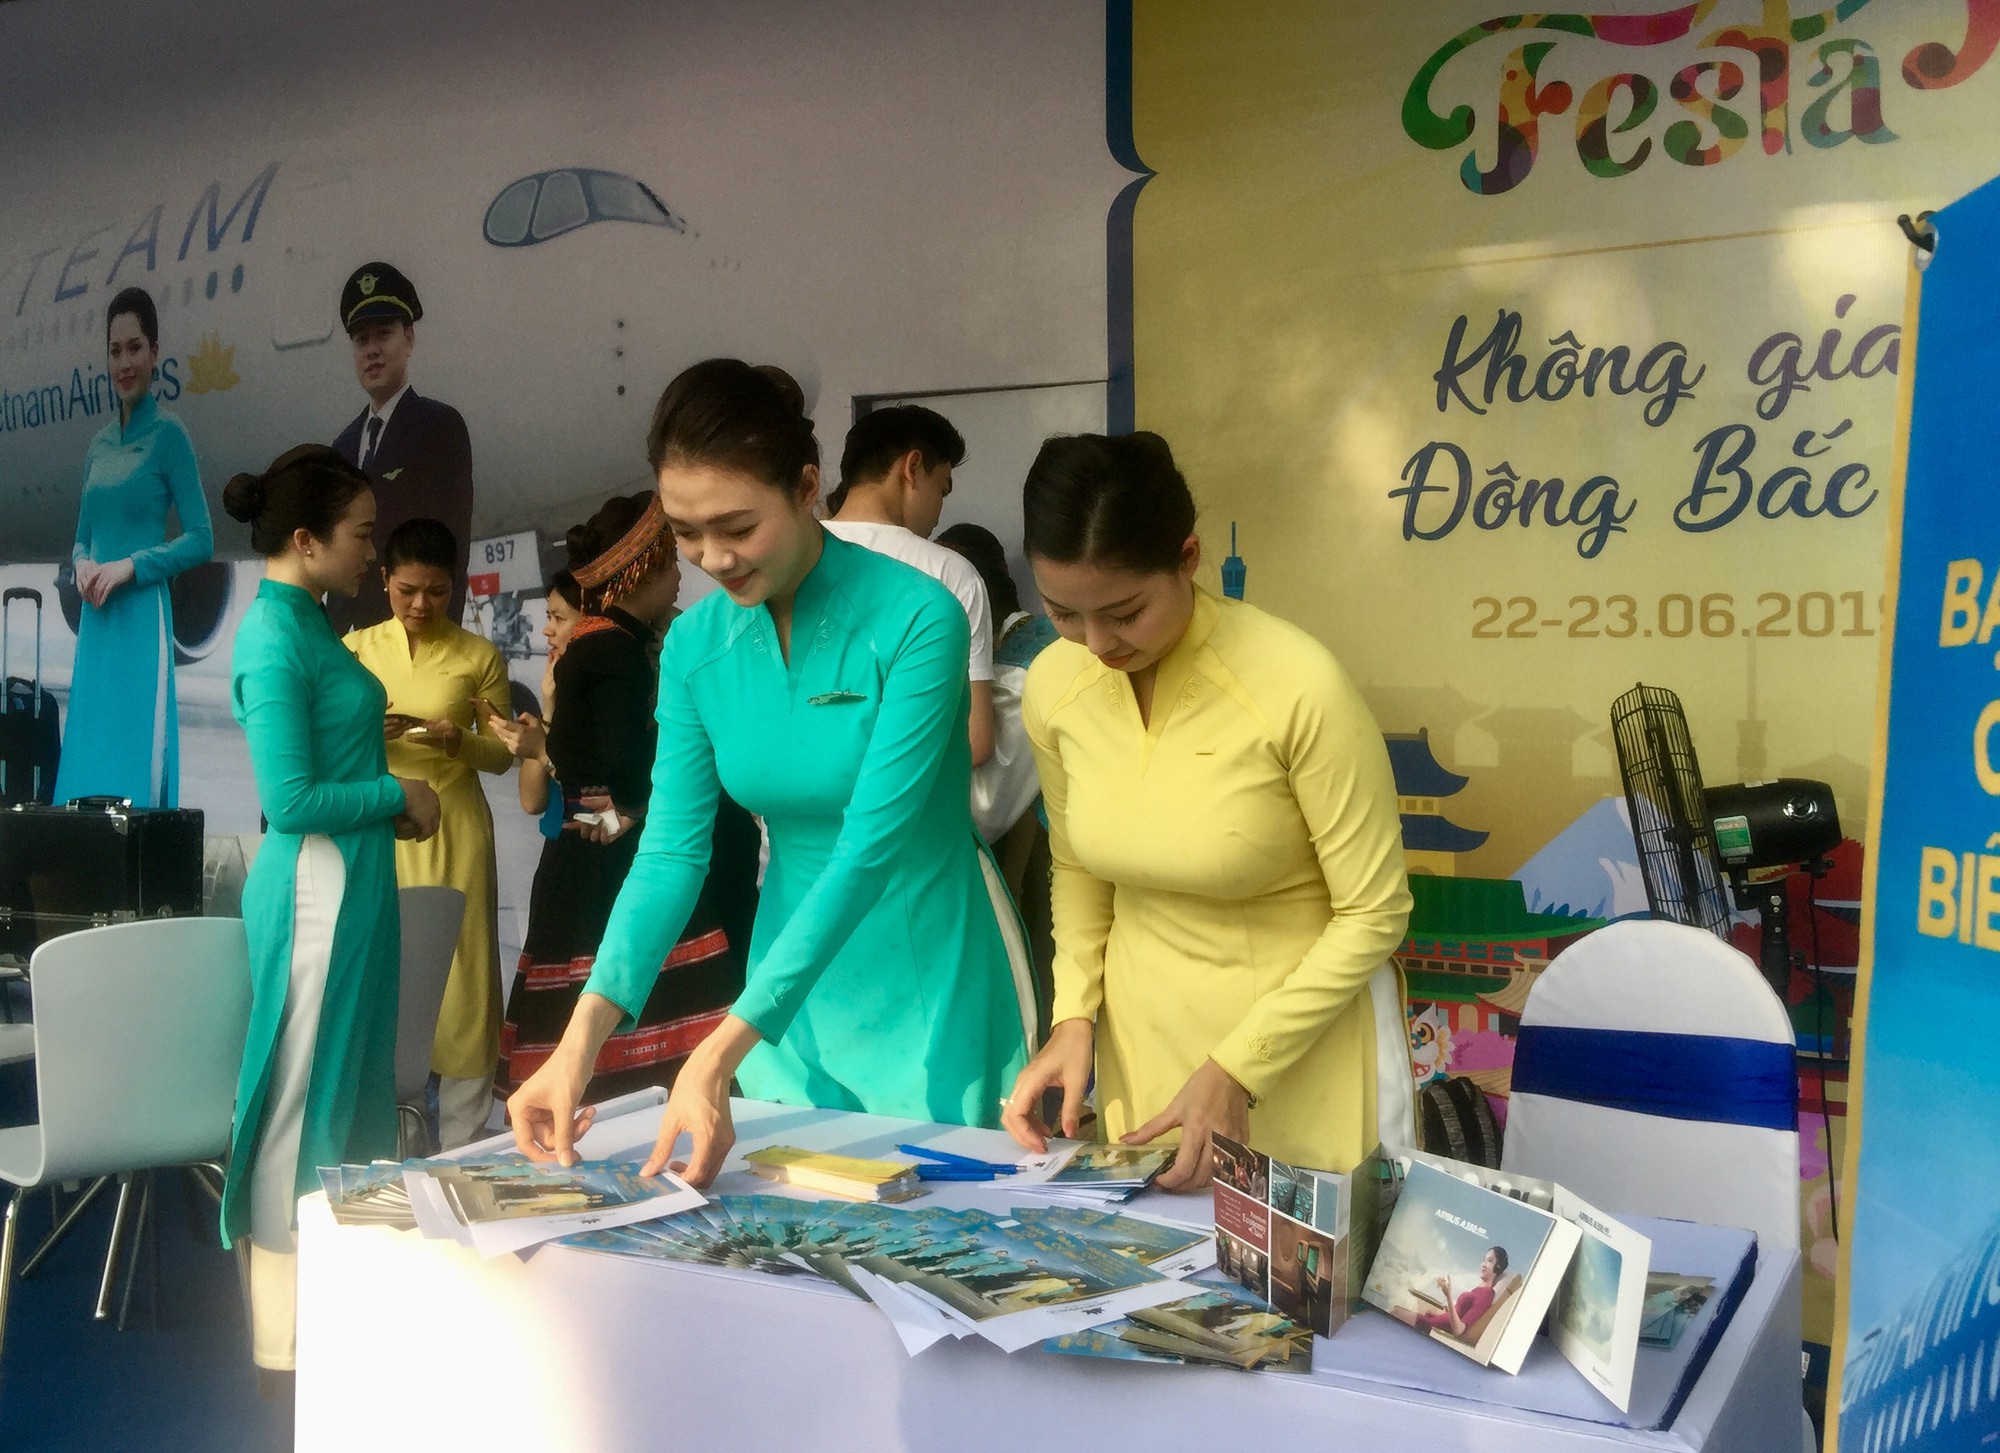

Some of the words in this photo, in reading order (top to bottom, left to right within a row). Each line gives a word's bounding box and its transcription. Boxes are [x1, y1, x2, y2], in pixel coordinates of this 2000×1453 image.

[1401, 0, 1900, 195] Festa
[0, 161, 283, 317] TEAM
[1432, 308, 1706, 427] Không
[1388, 441, 1637, 559] Đông
[1673, 419, 1878, 533] Bắc
[485, 539, 515, 564] 897
[1471, 590, 1886, 640] 22-23.06.201
[1435, 1208, 1460, 1226] AIRBUS
